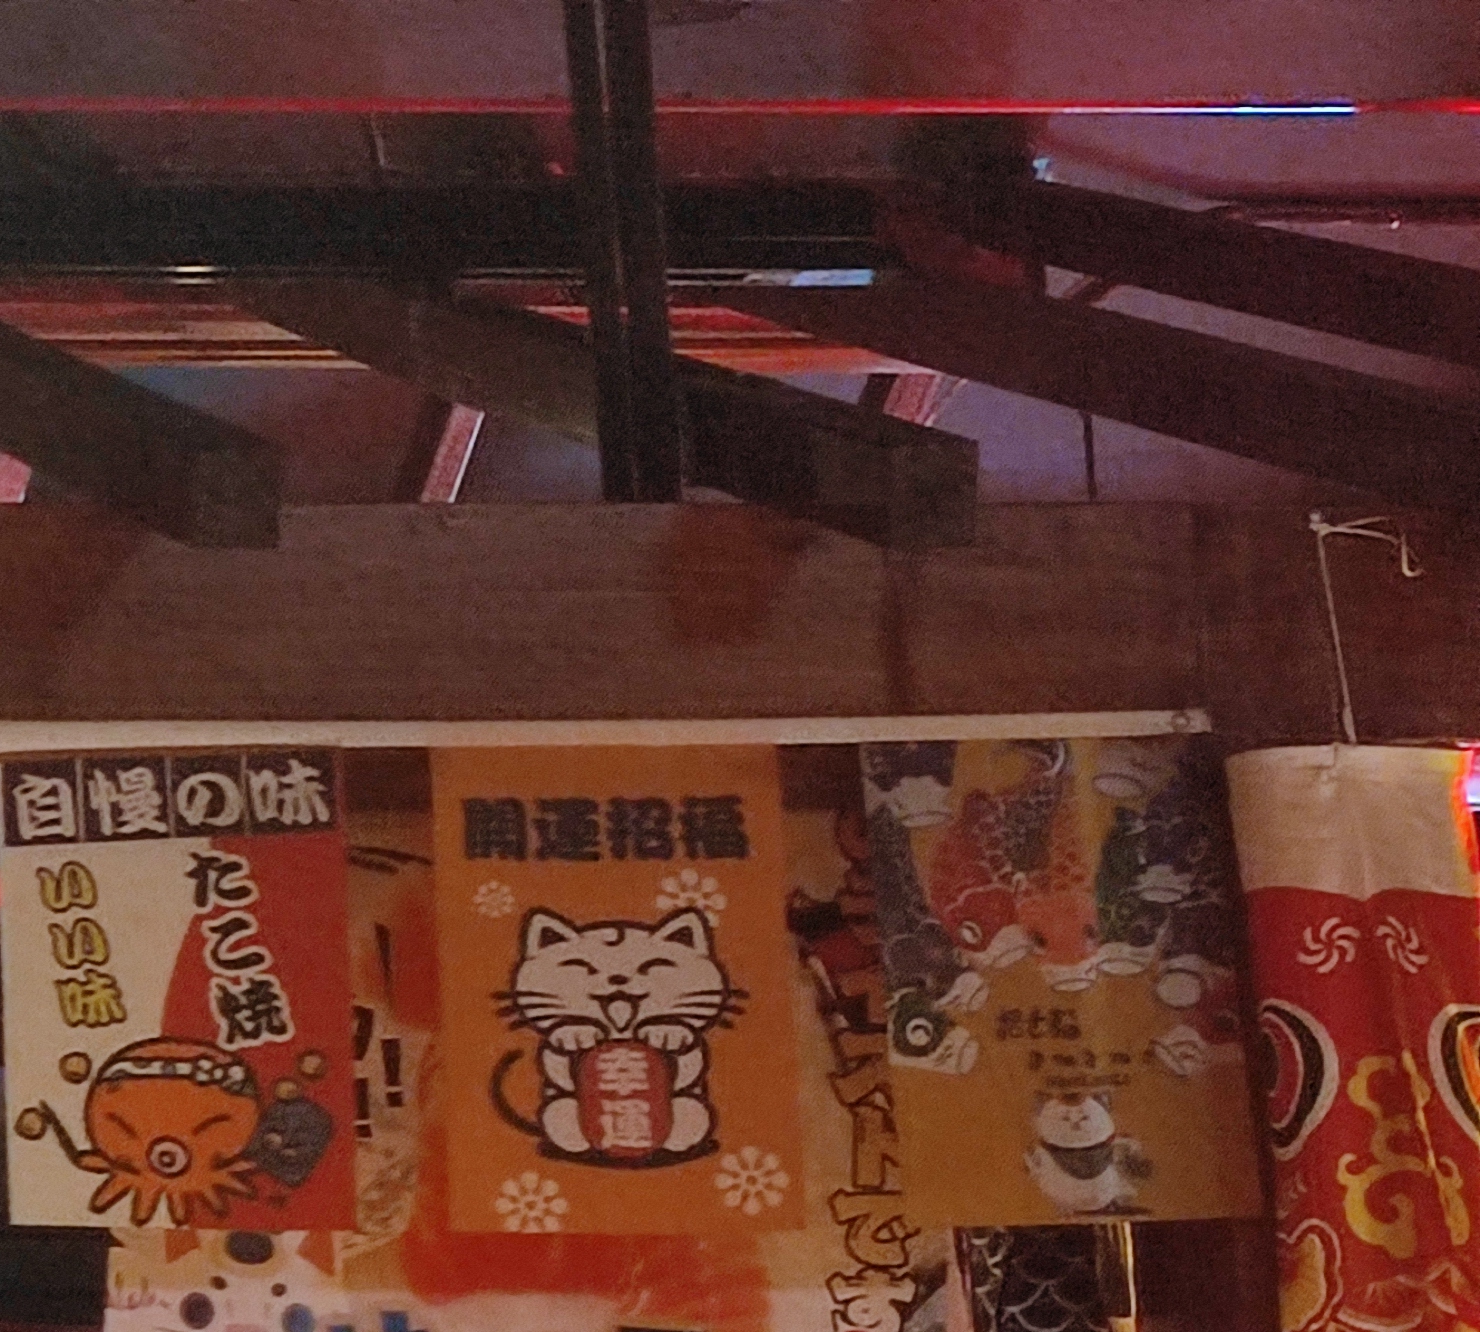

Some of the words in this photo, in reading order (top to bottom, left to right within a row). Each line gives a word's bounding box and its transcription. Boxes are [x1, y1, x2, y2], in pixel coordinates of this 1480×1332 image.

[12, 756, 332, 842] 自慢の味
[37, 860, 127, 1029] いい味
